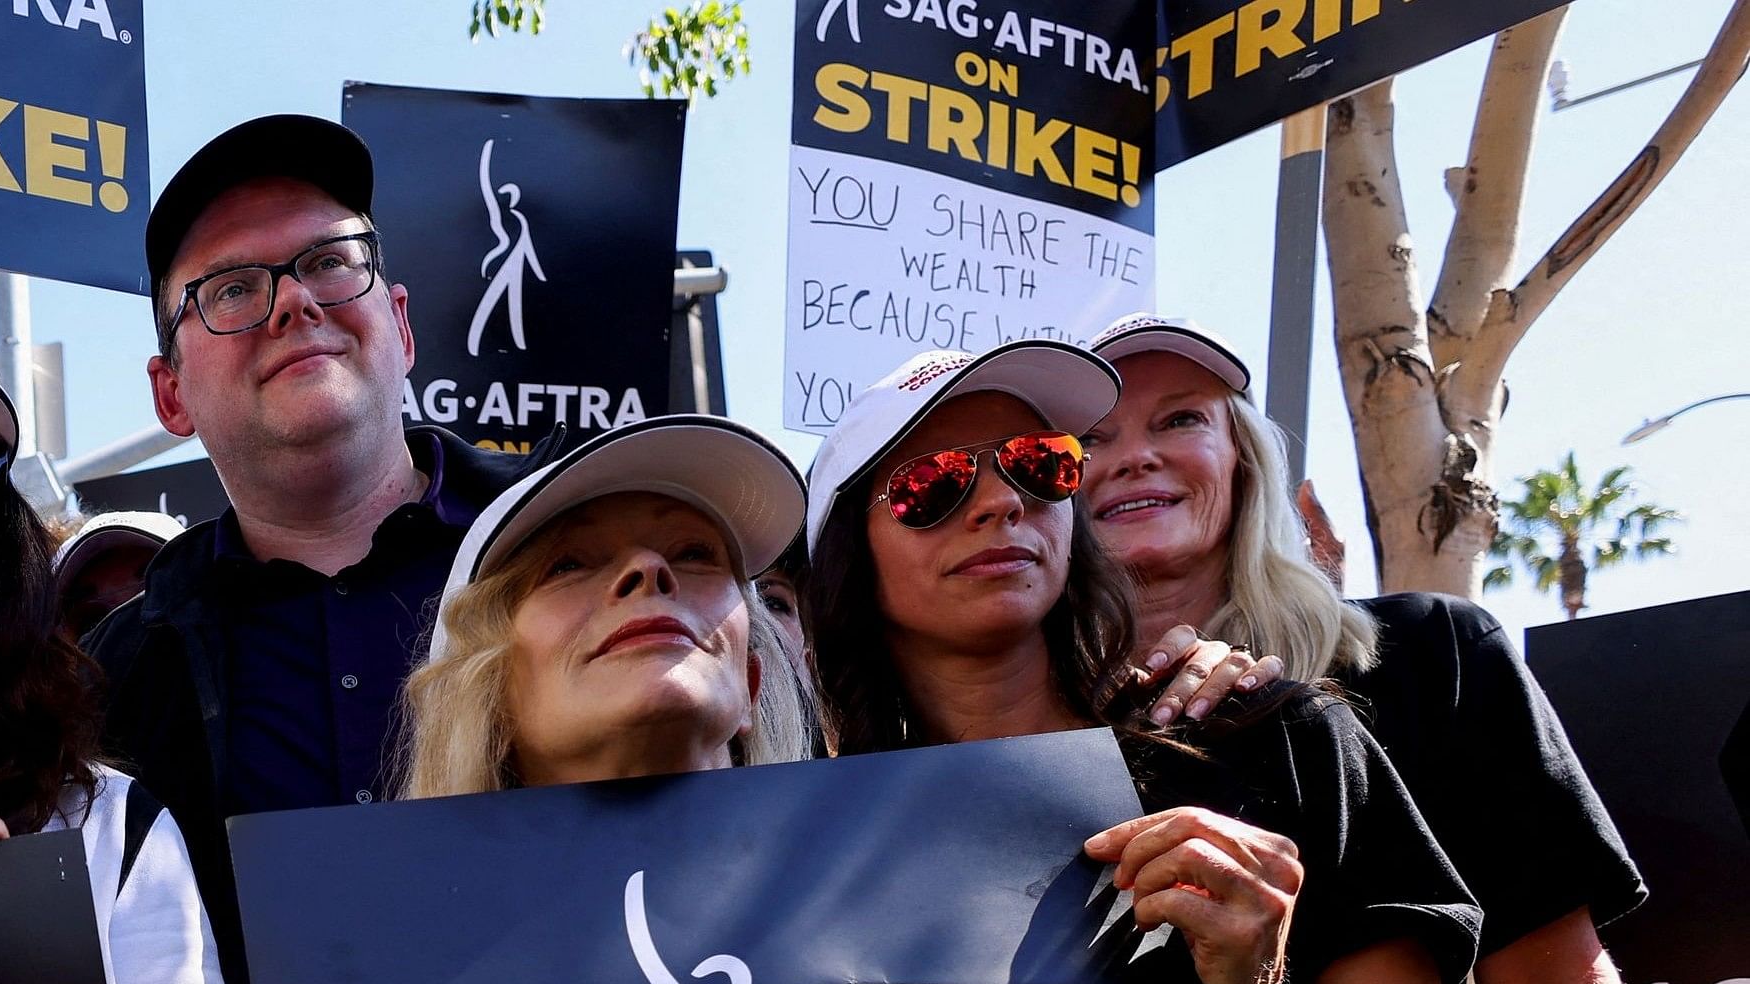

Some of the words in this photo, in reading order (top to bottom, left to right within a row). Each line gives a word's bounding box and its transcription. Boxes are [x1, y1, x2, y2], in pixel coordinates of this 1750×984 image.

[955, 51, 1018, 97] ON
[813, 62, 1141, 208] STRIKE!
[799, 166, 899, 226] YOU
[926, 194, 1066, 265] SHARE
[1084, 232, 1143, 285] THE
[900, 246, 1036, 299] WEALTH
[803, 280, 978, 353] BECAUSE
